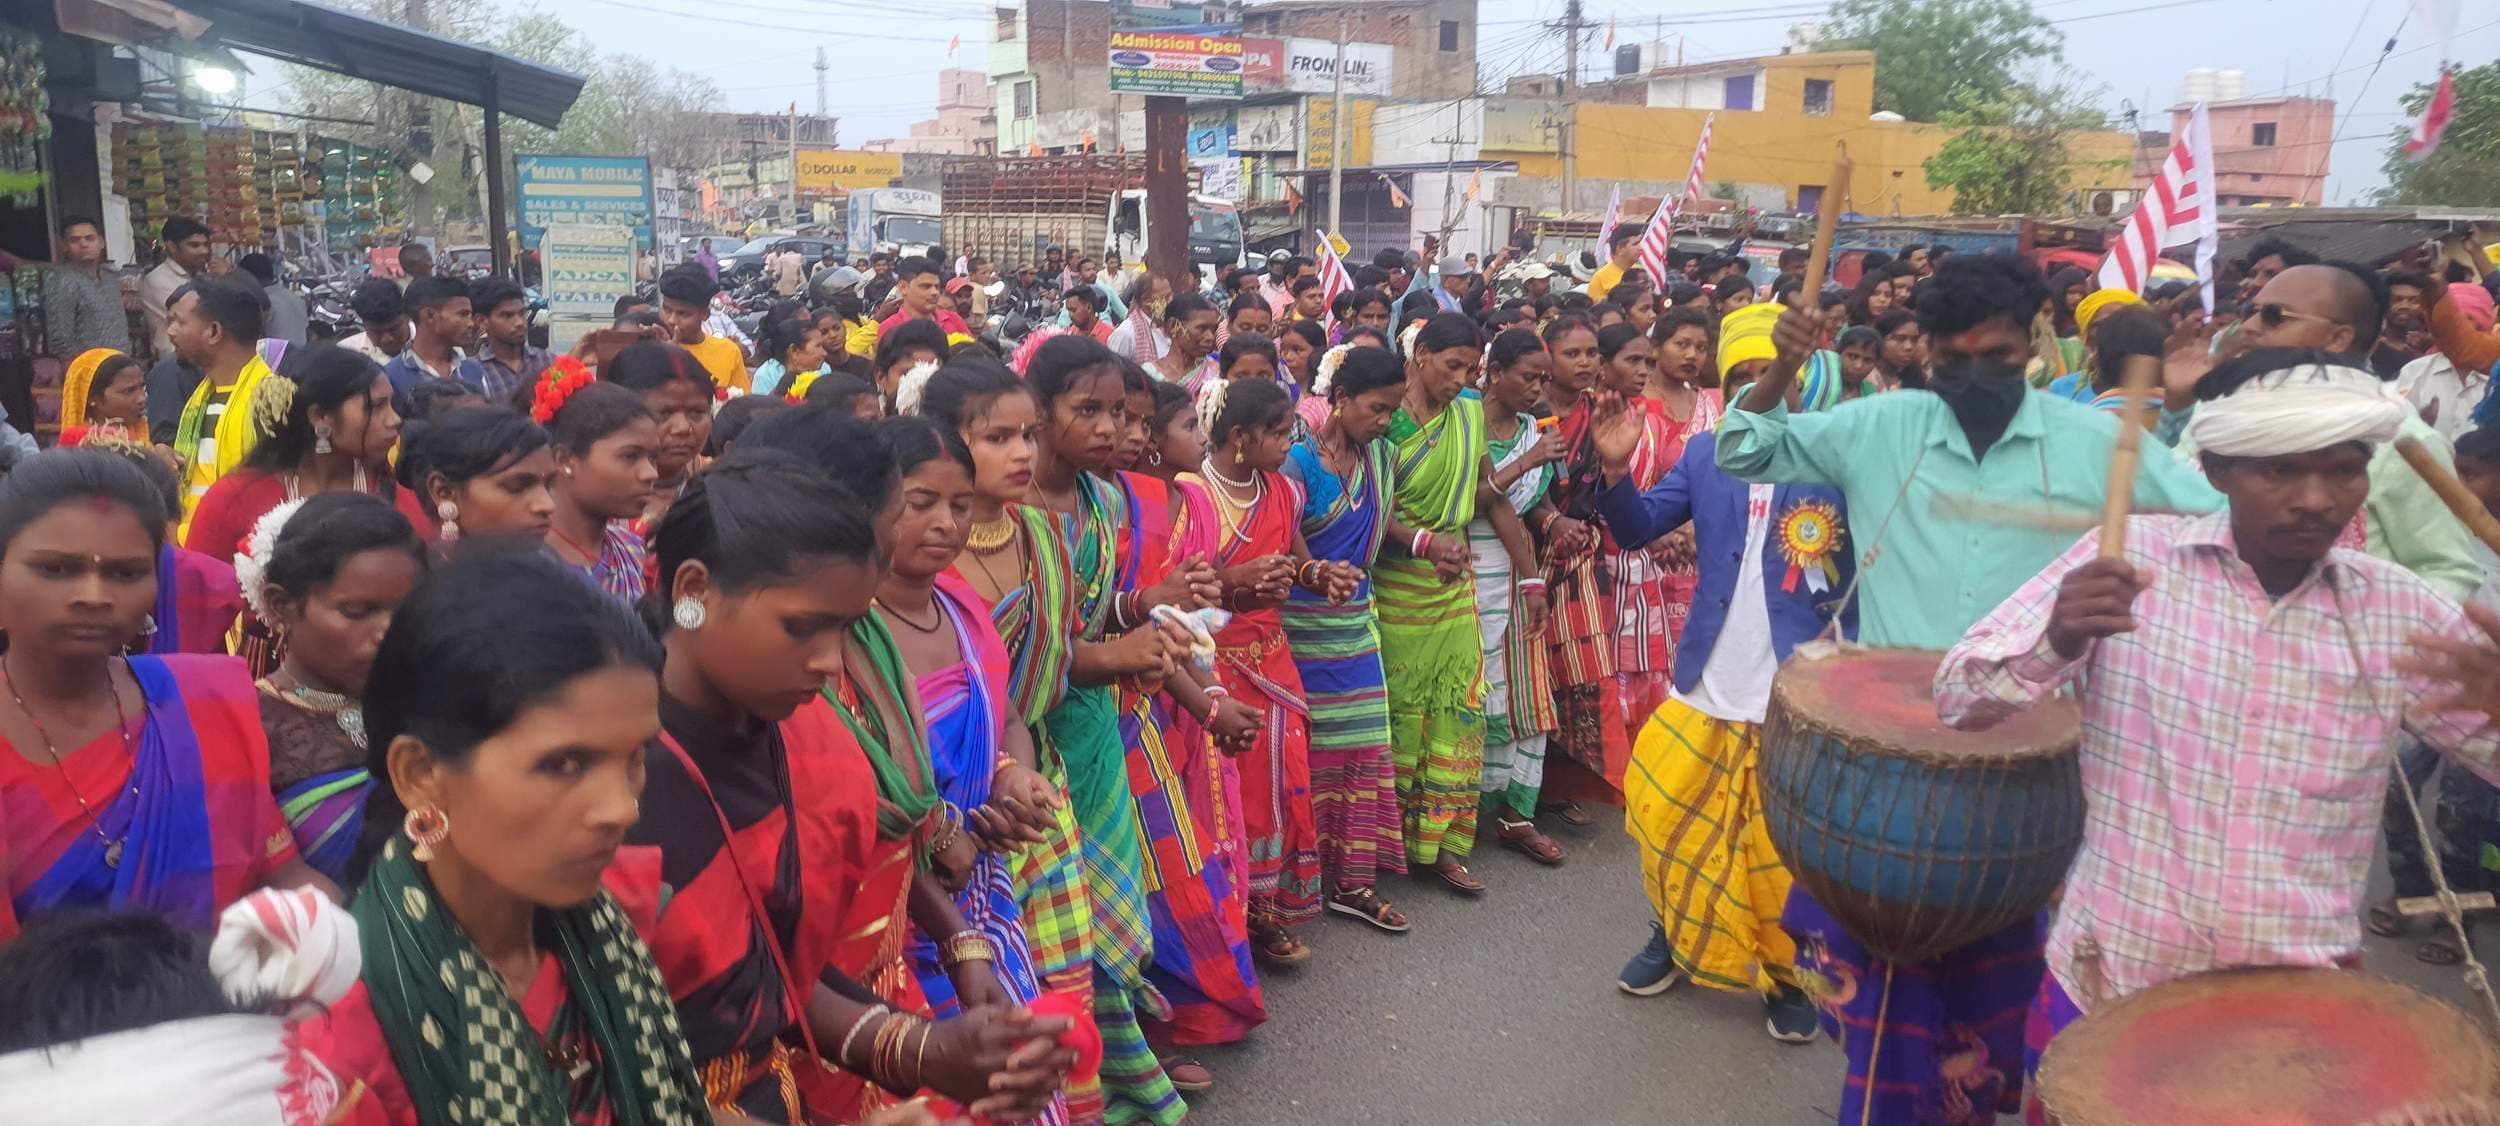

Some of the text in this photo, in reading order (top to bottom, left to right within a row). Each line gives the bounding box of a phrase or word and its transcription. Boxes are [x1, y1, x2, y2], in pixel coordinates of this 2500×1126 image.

[1111, 33, 1242, 54] Admission Open
[1291, 55, 1375, 76] FRONLINE
[532, 166, 643, 181] MAYA MOBILE
[813, 164, 857, 175] DOLLAR
[525, 200, 646, 211] SALES & SERVICES
[554, 271, 627, 281] ADCA
